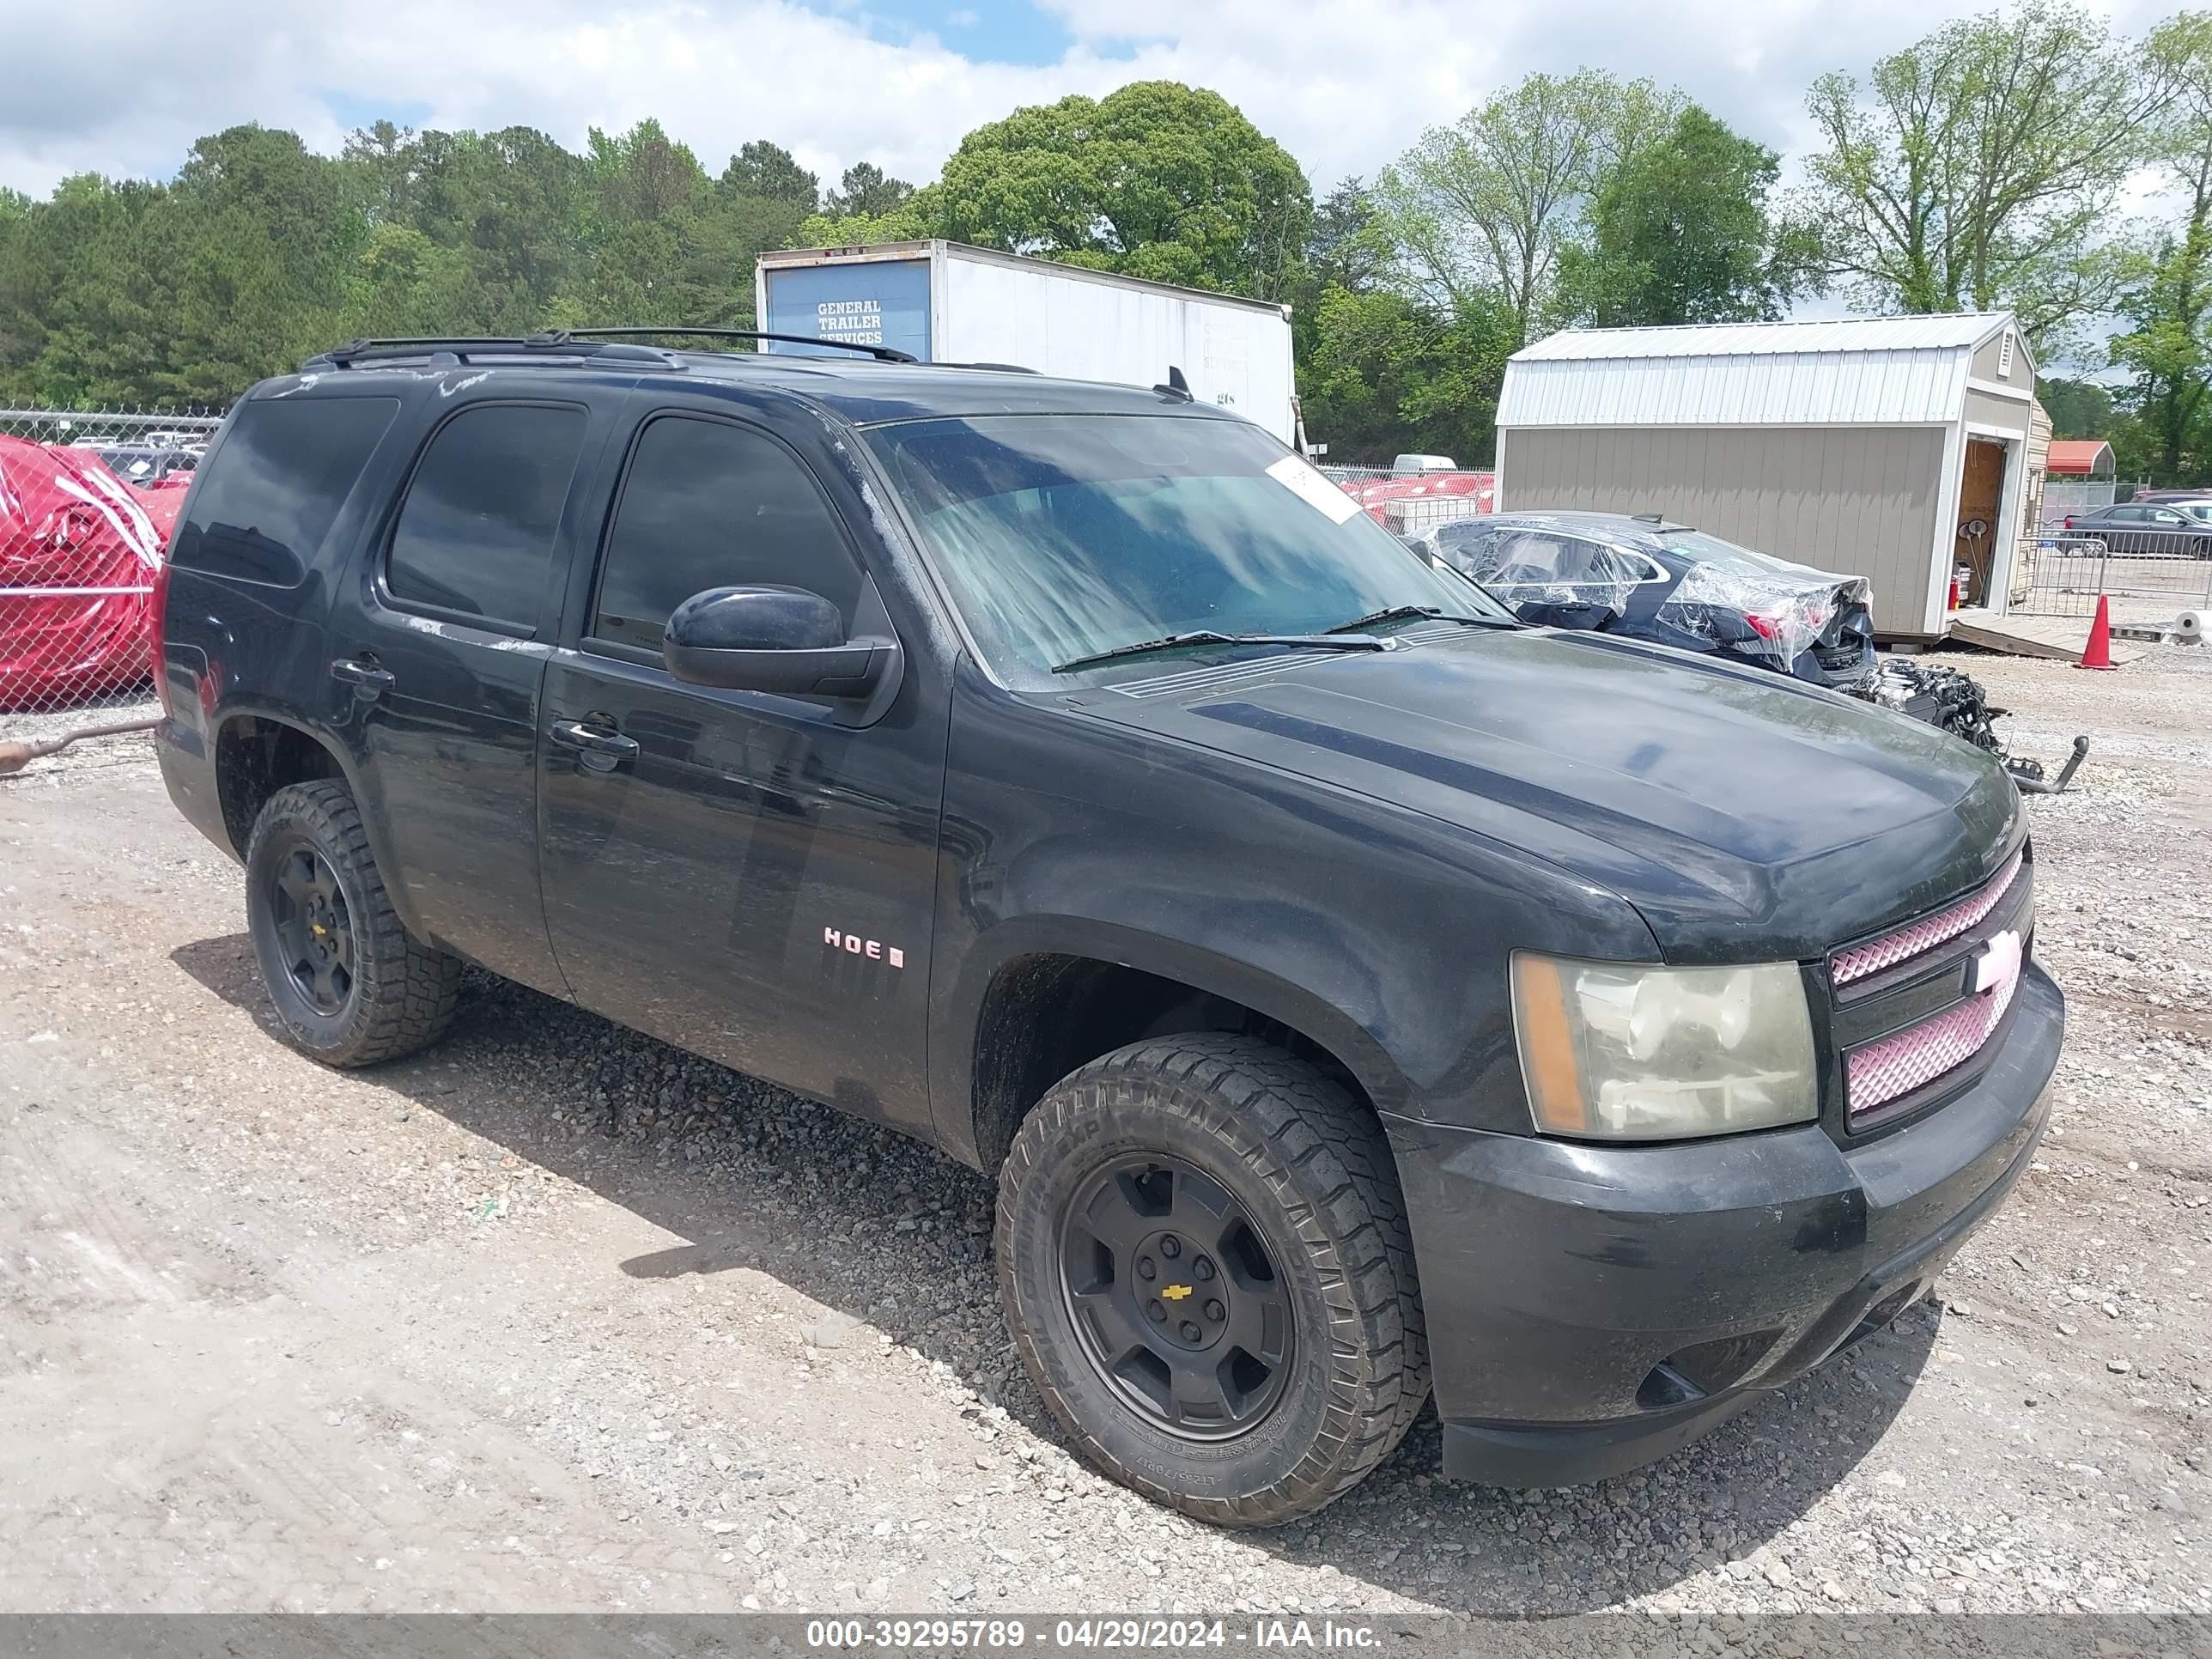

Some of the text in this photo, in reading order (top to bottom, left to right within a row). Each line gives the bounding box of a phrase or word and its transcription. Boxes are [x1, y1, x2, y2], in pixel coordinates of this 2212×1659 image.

[817, 300, 881, 315] GENERAL
[818, 315, 882, 331] TRAILER
[1217, 392, 1235, 406] gts
[824, 927, 882, 960] HOE
[1054, 1119, 1101, 1158] EXP
[1136, 1455, 1216, 1486] LT265/70R17
